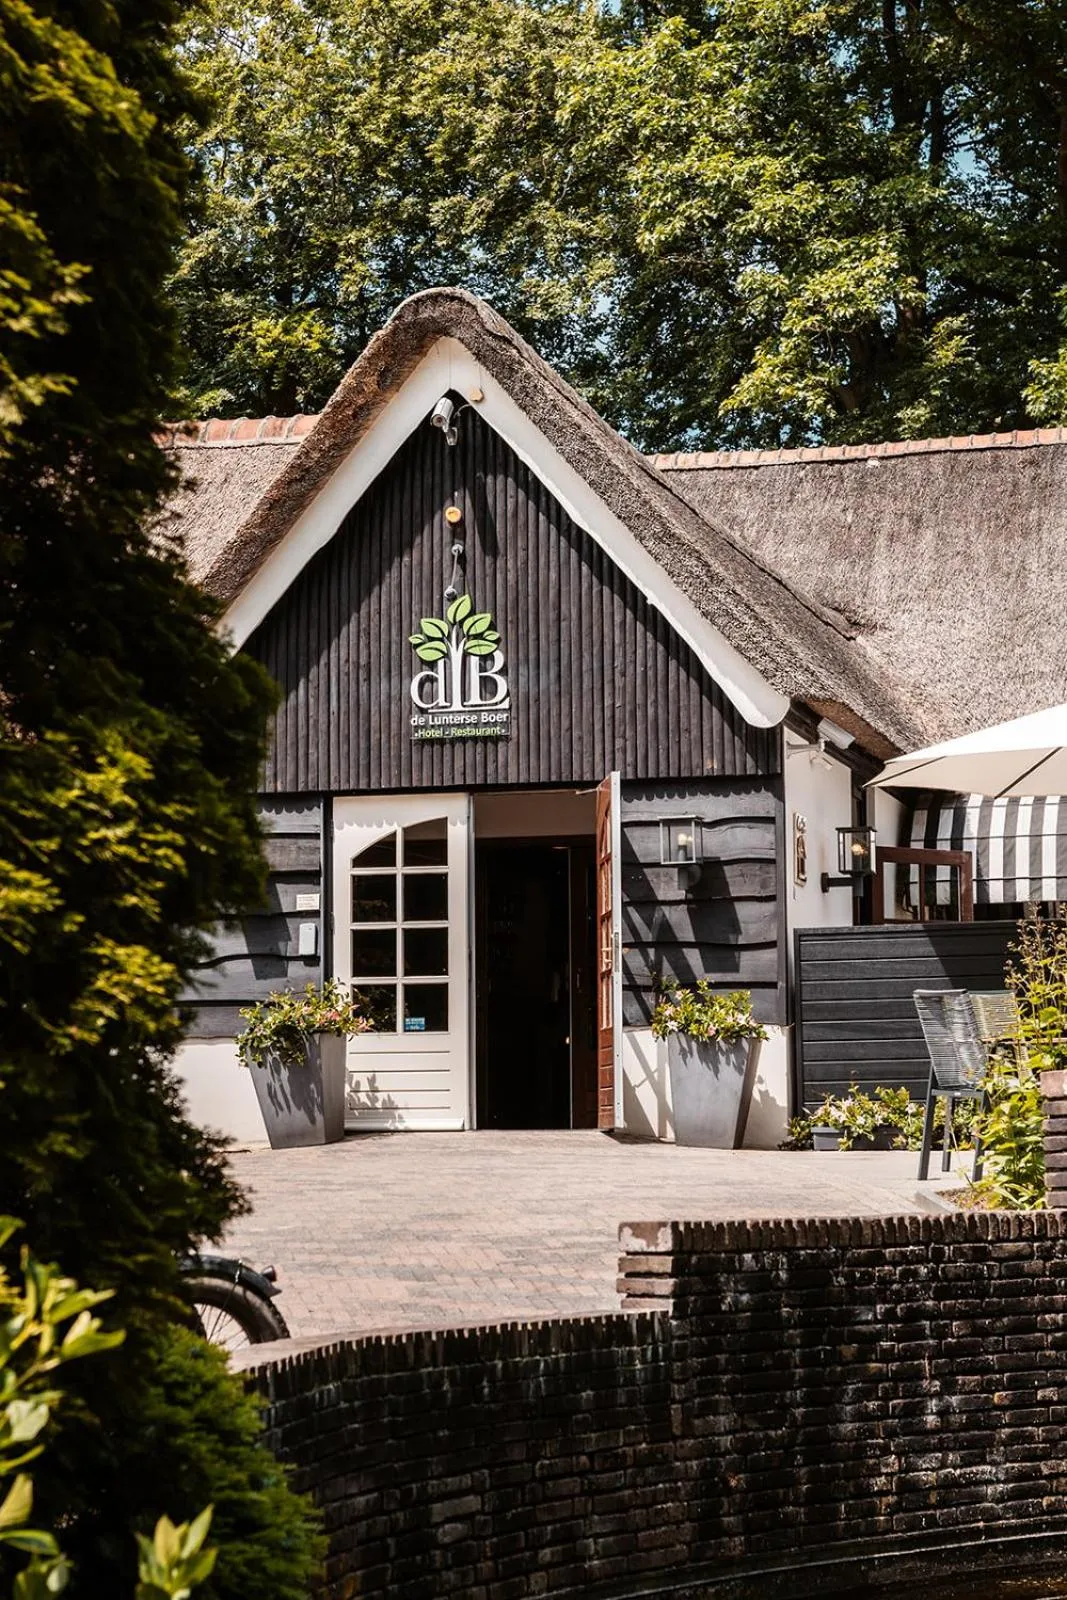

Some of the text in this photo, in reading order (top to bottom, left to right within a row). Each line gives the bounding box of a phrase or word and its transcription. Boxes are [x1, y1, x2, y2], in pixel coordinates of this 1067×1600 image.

[411, 712, 508, 725] de Lunterse Boer
[418, 727, 443, 737] Hotel
[451, 726, 500, 736] Restaurant
